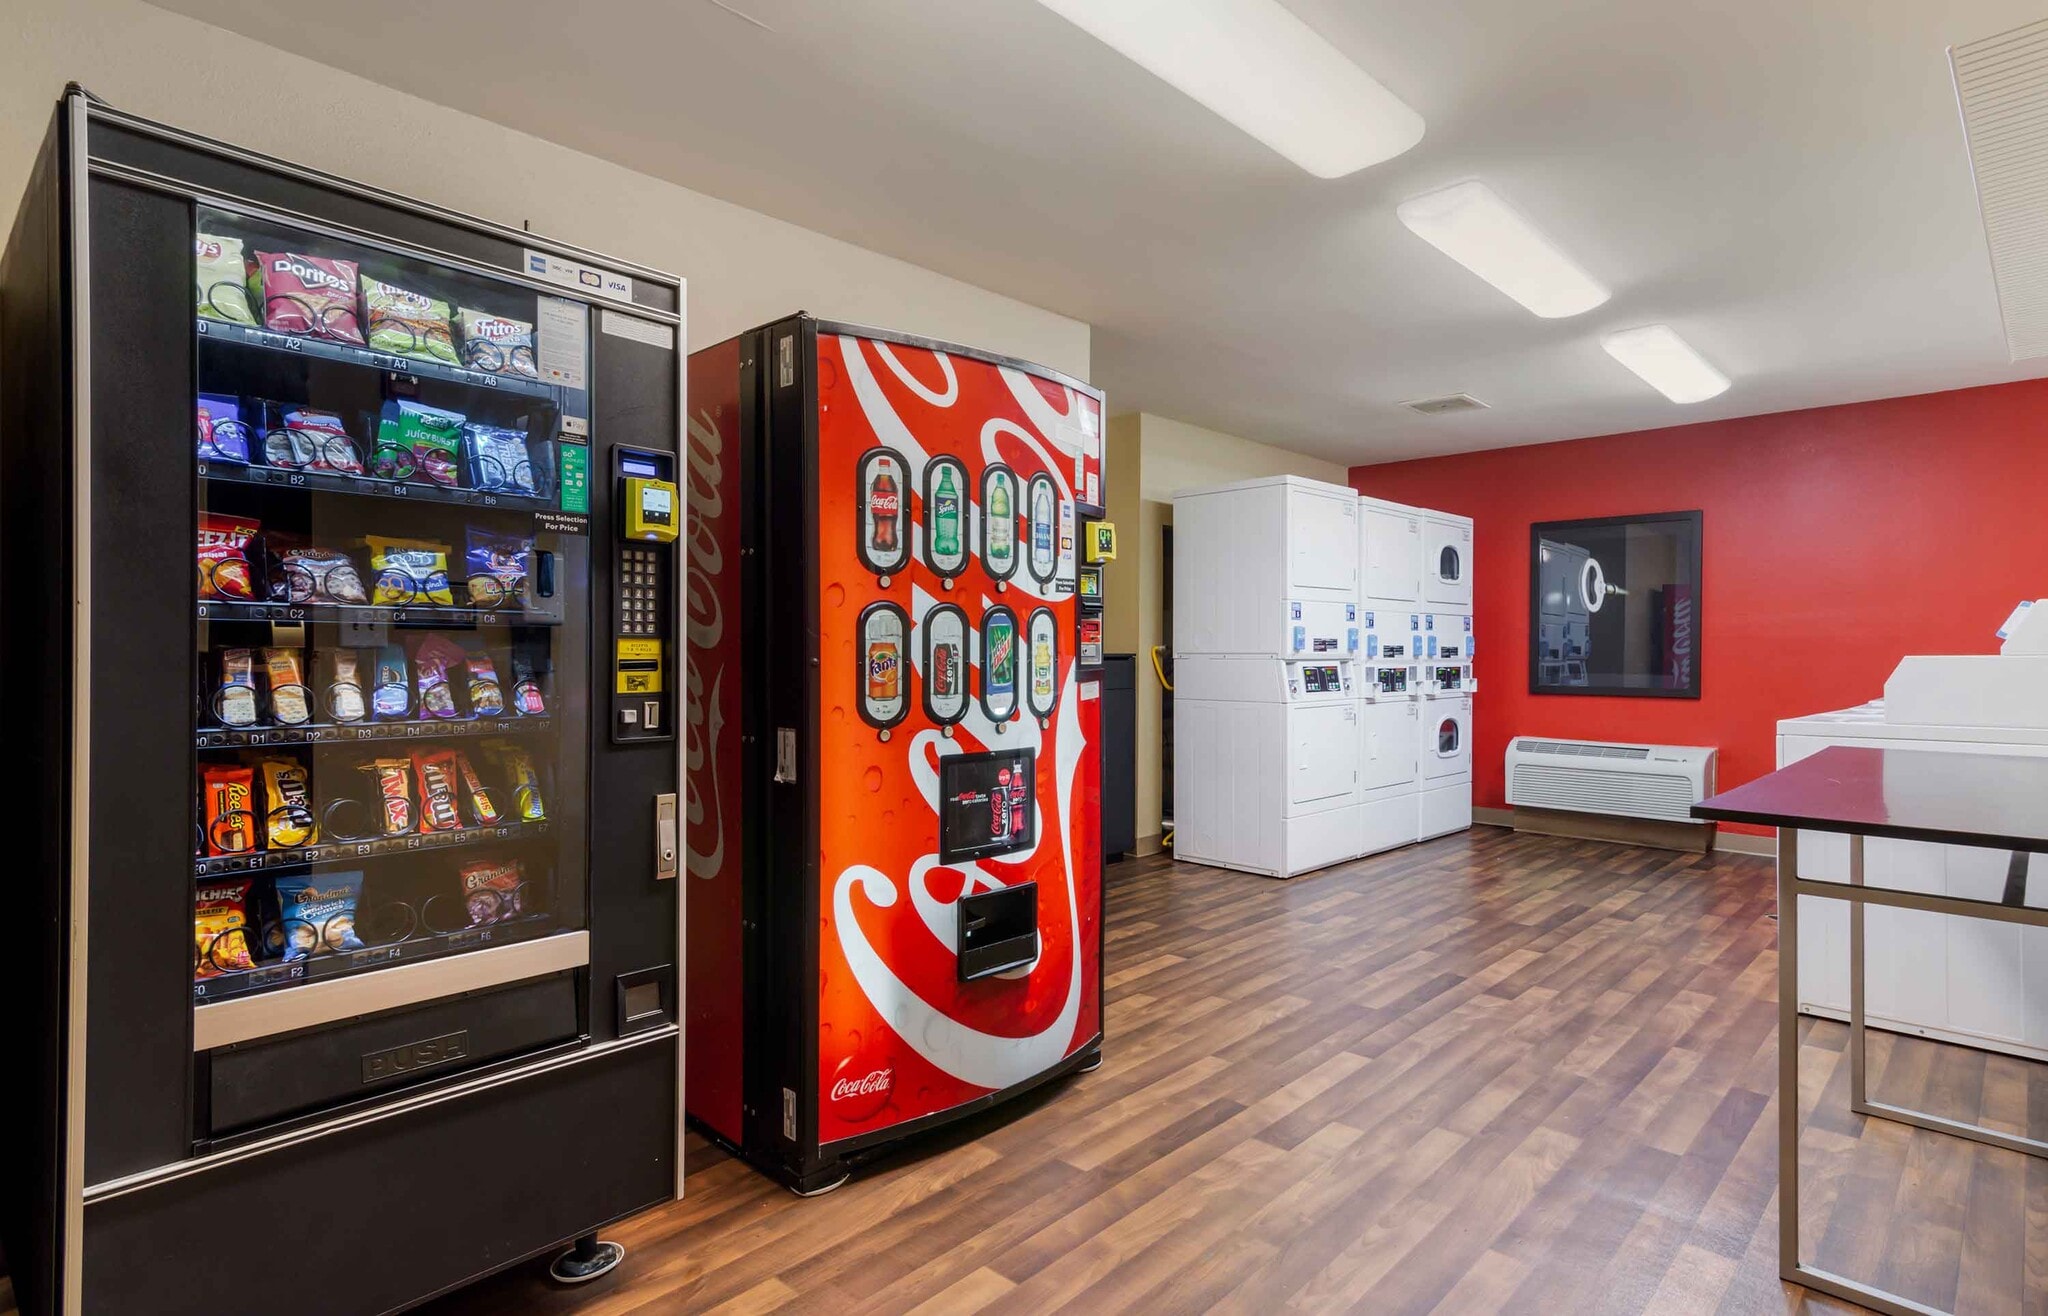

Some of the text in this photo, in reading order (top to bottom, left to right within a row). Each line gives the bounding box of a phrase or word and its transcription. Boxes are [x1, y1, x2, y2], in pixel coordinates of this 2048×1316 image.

[274, 259, 350, 292] Doritos
[608, 281, 626, 292] VISA
[285, 339, 301, 350] A2
[393, 359, 408, 370] A4
[484, 376, 497, 387] A6
[290, 475, 305, 486] B2
[394, 486, 407, 496] B4
[485, 496, 497, 505] B6
[938, 502, 955, 514] Sprite
[535, 513, 588, 524] Press Selection
[545, 522, 579, 532] For Price
[290, 609, 305, 619] C2
[393, 612, 406, 621] C4
[484, 615, 496, 624] C6
[453, 725, 466, 734] D5
[498, 722, 510, 731] D6
[539, 720, 550, 729] D7
[306, 732, 321, 742] D2
[358, 729, 372, 739] D3
[407, 727, 420, 737] D4
[251, 734, 266, 744] D1
[497, 828, 508, 837] E6
[408, 839, 419, 848] E4
[455, 834, 466, 843] E5
[357, 844, 371, 854] E3
[305, 851, 319, 861] E2
[250, 858, 263, 868] E1
[196, 886, 245, 903] CHIES
[480, 932, 491, 941] F6
[389, 948, 401, 959] F4
[290, 967, 304, 978] F2
[830, 1068, 893, 1102] Coca-Cola
